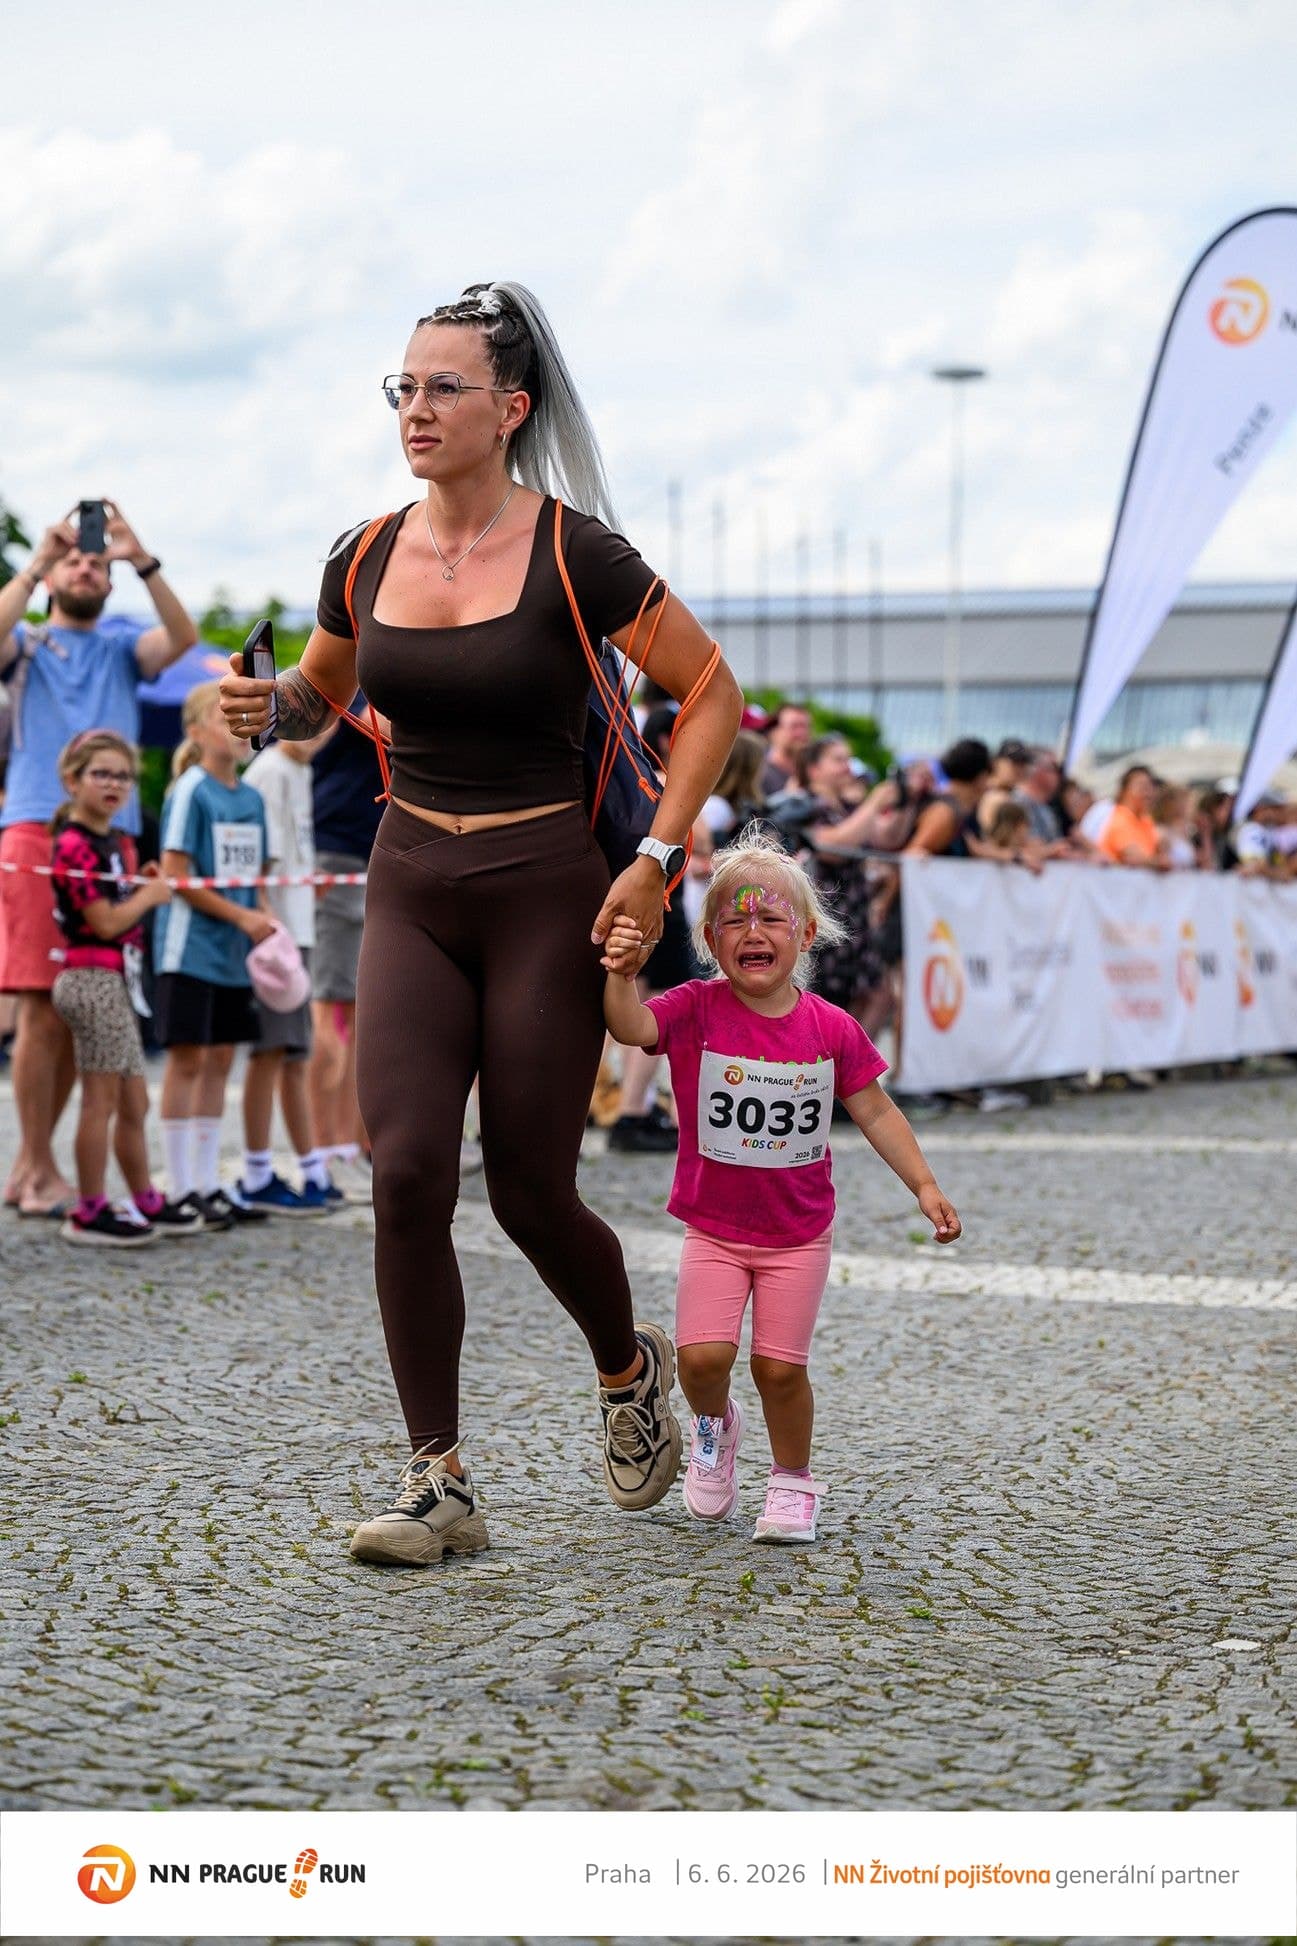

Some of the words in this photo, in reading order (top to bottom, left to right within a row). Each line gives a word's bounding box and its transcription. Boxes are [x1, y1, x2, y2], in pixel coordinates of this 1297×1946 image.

[747, 1074, 761, 1083] NN
[763, 1076, 794, 1086] PRAGUE
[803, 1076, 818, 1085] RUN
[708, 1091, 821, 1136] 3033
[741, 1137, 765, 1149] KIDS
[766, 1140, 787, 1151] CUP
